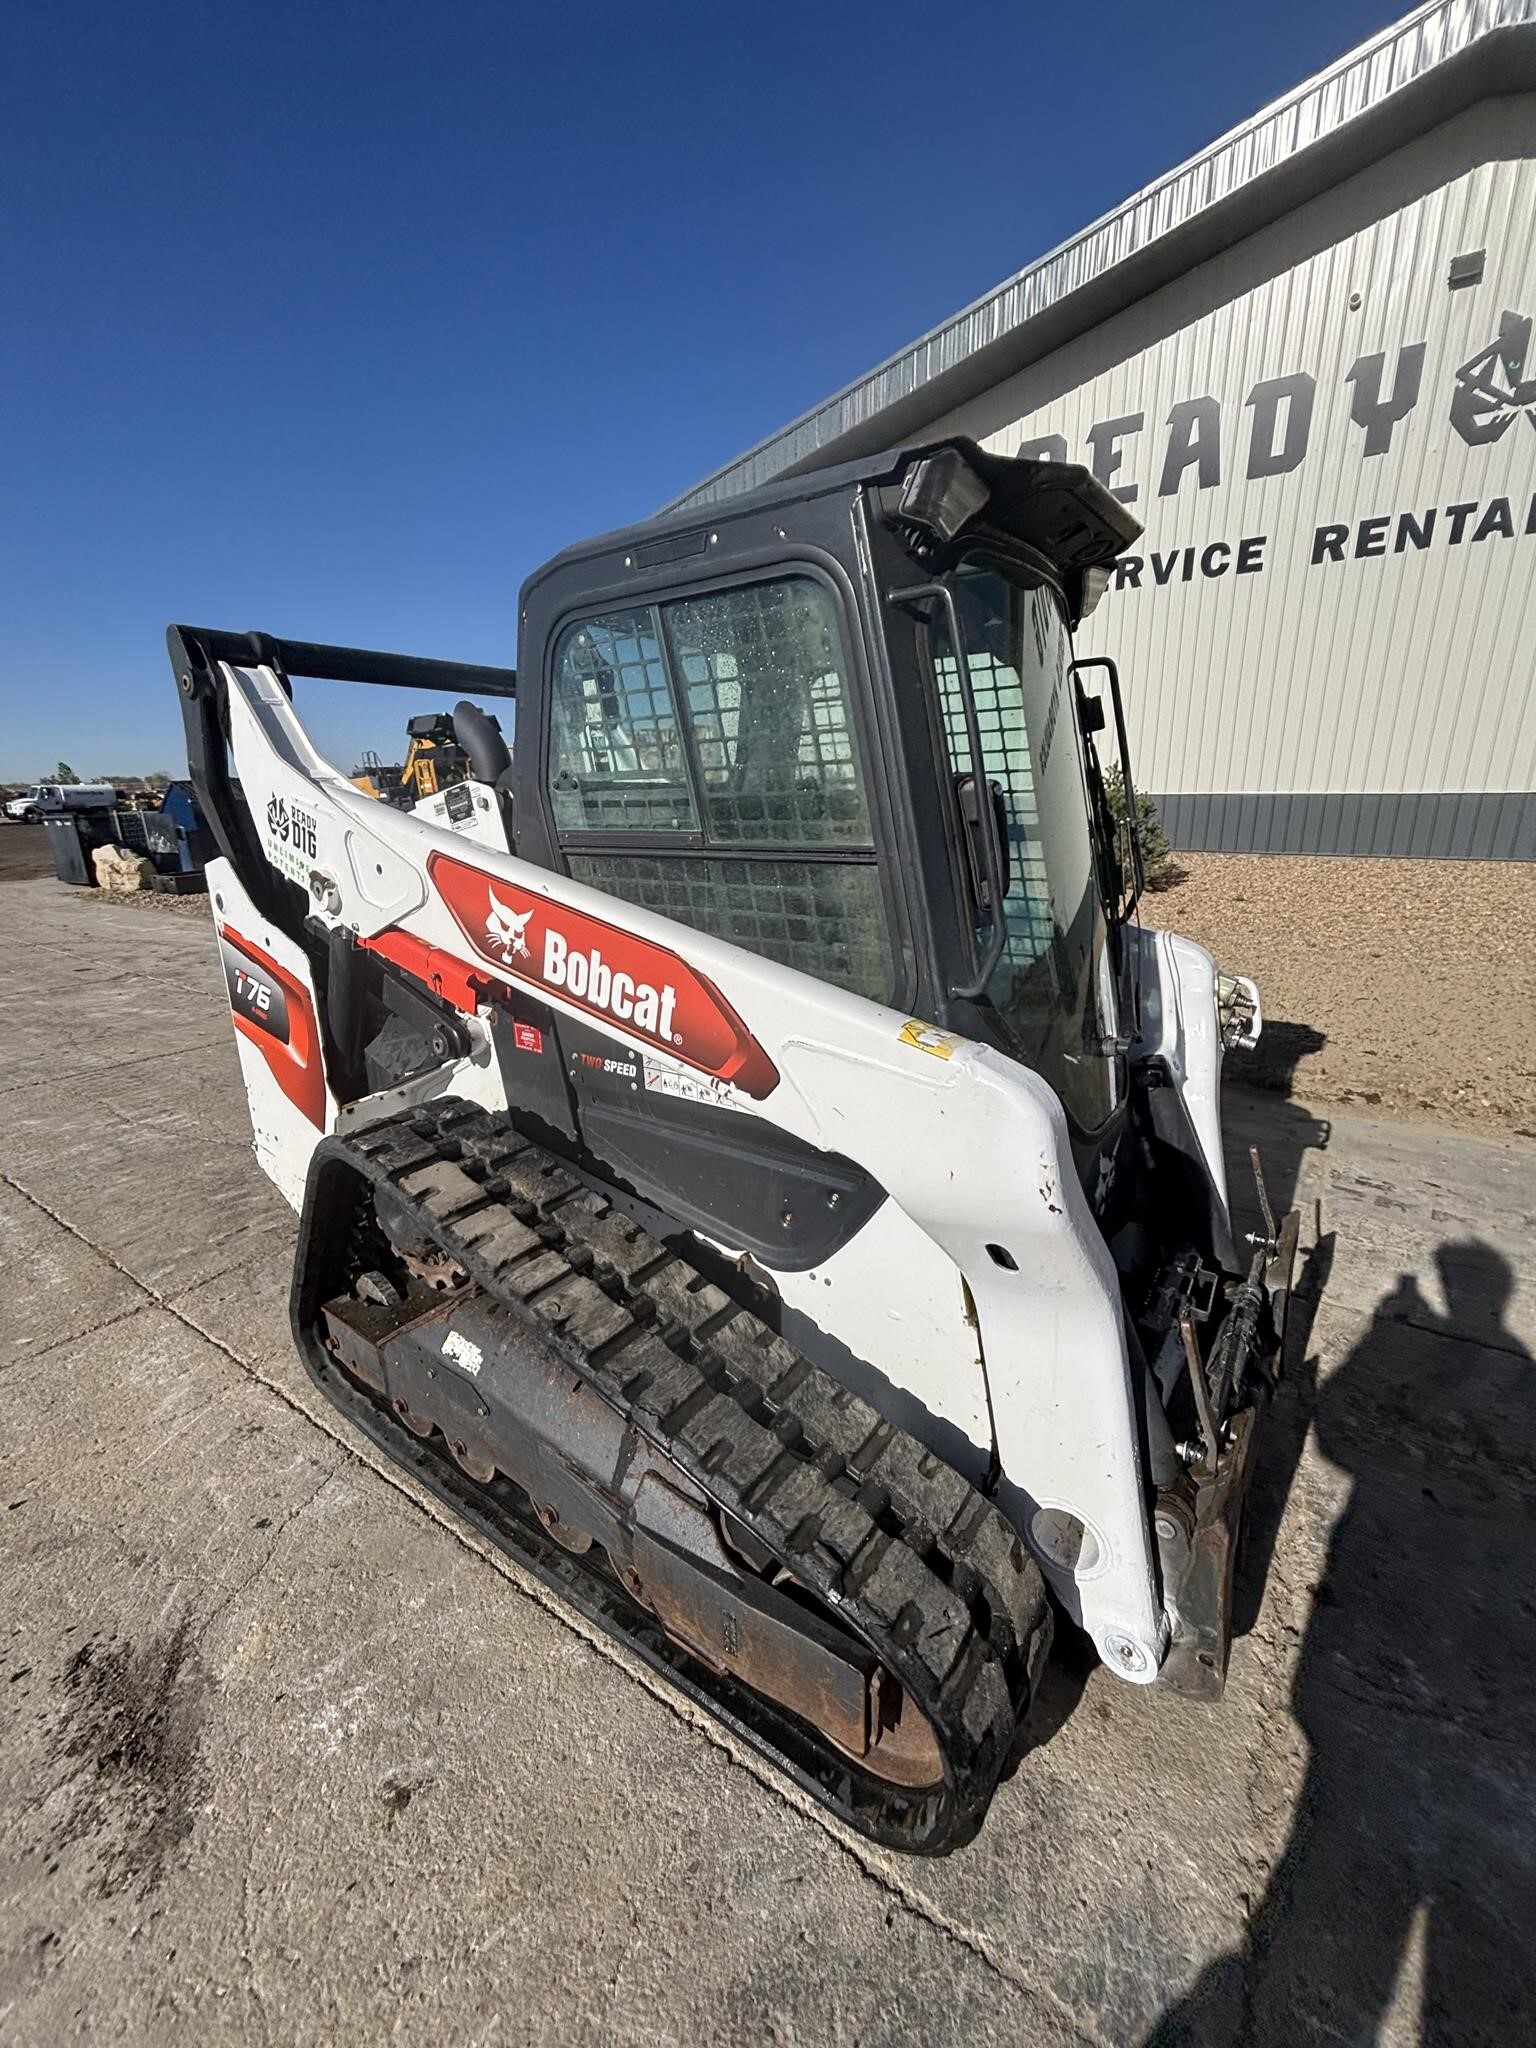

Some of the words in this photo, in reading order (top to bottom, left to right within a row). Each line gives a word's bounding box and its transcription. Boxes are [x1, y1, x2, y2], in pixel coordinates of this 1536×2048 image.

[1104, 536, 1268, 592] RVICE
[291, 805, 317, 832] READY
[291, 820, 317, 860] DIG
[234, 968, 272, 1011] T76
[543, 927, 677, 1042] Bobcat
[580, 1053, 602, 1069] TWO
[603, 1058, 637, 1078] SPEED
